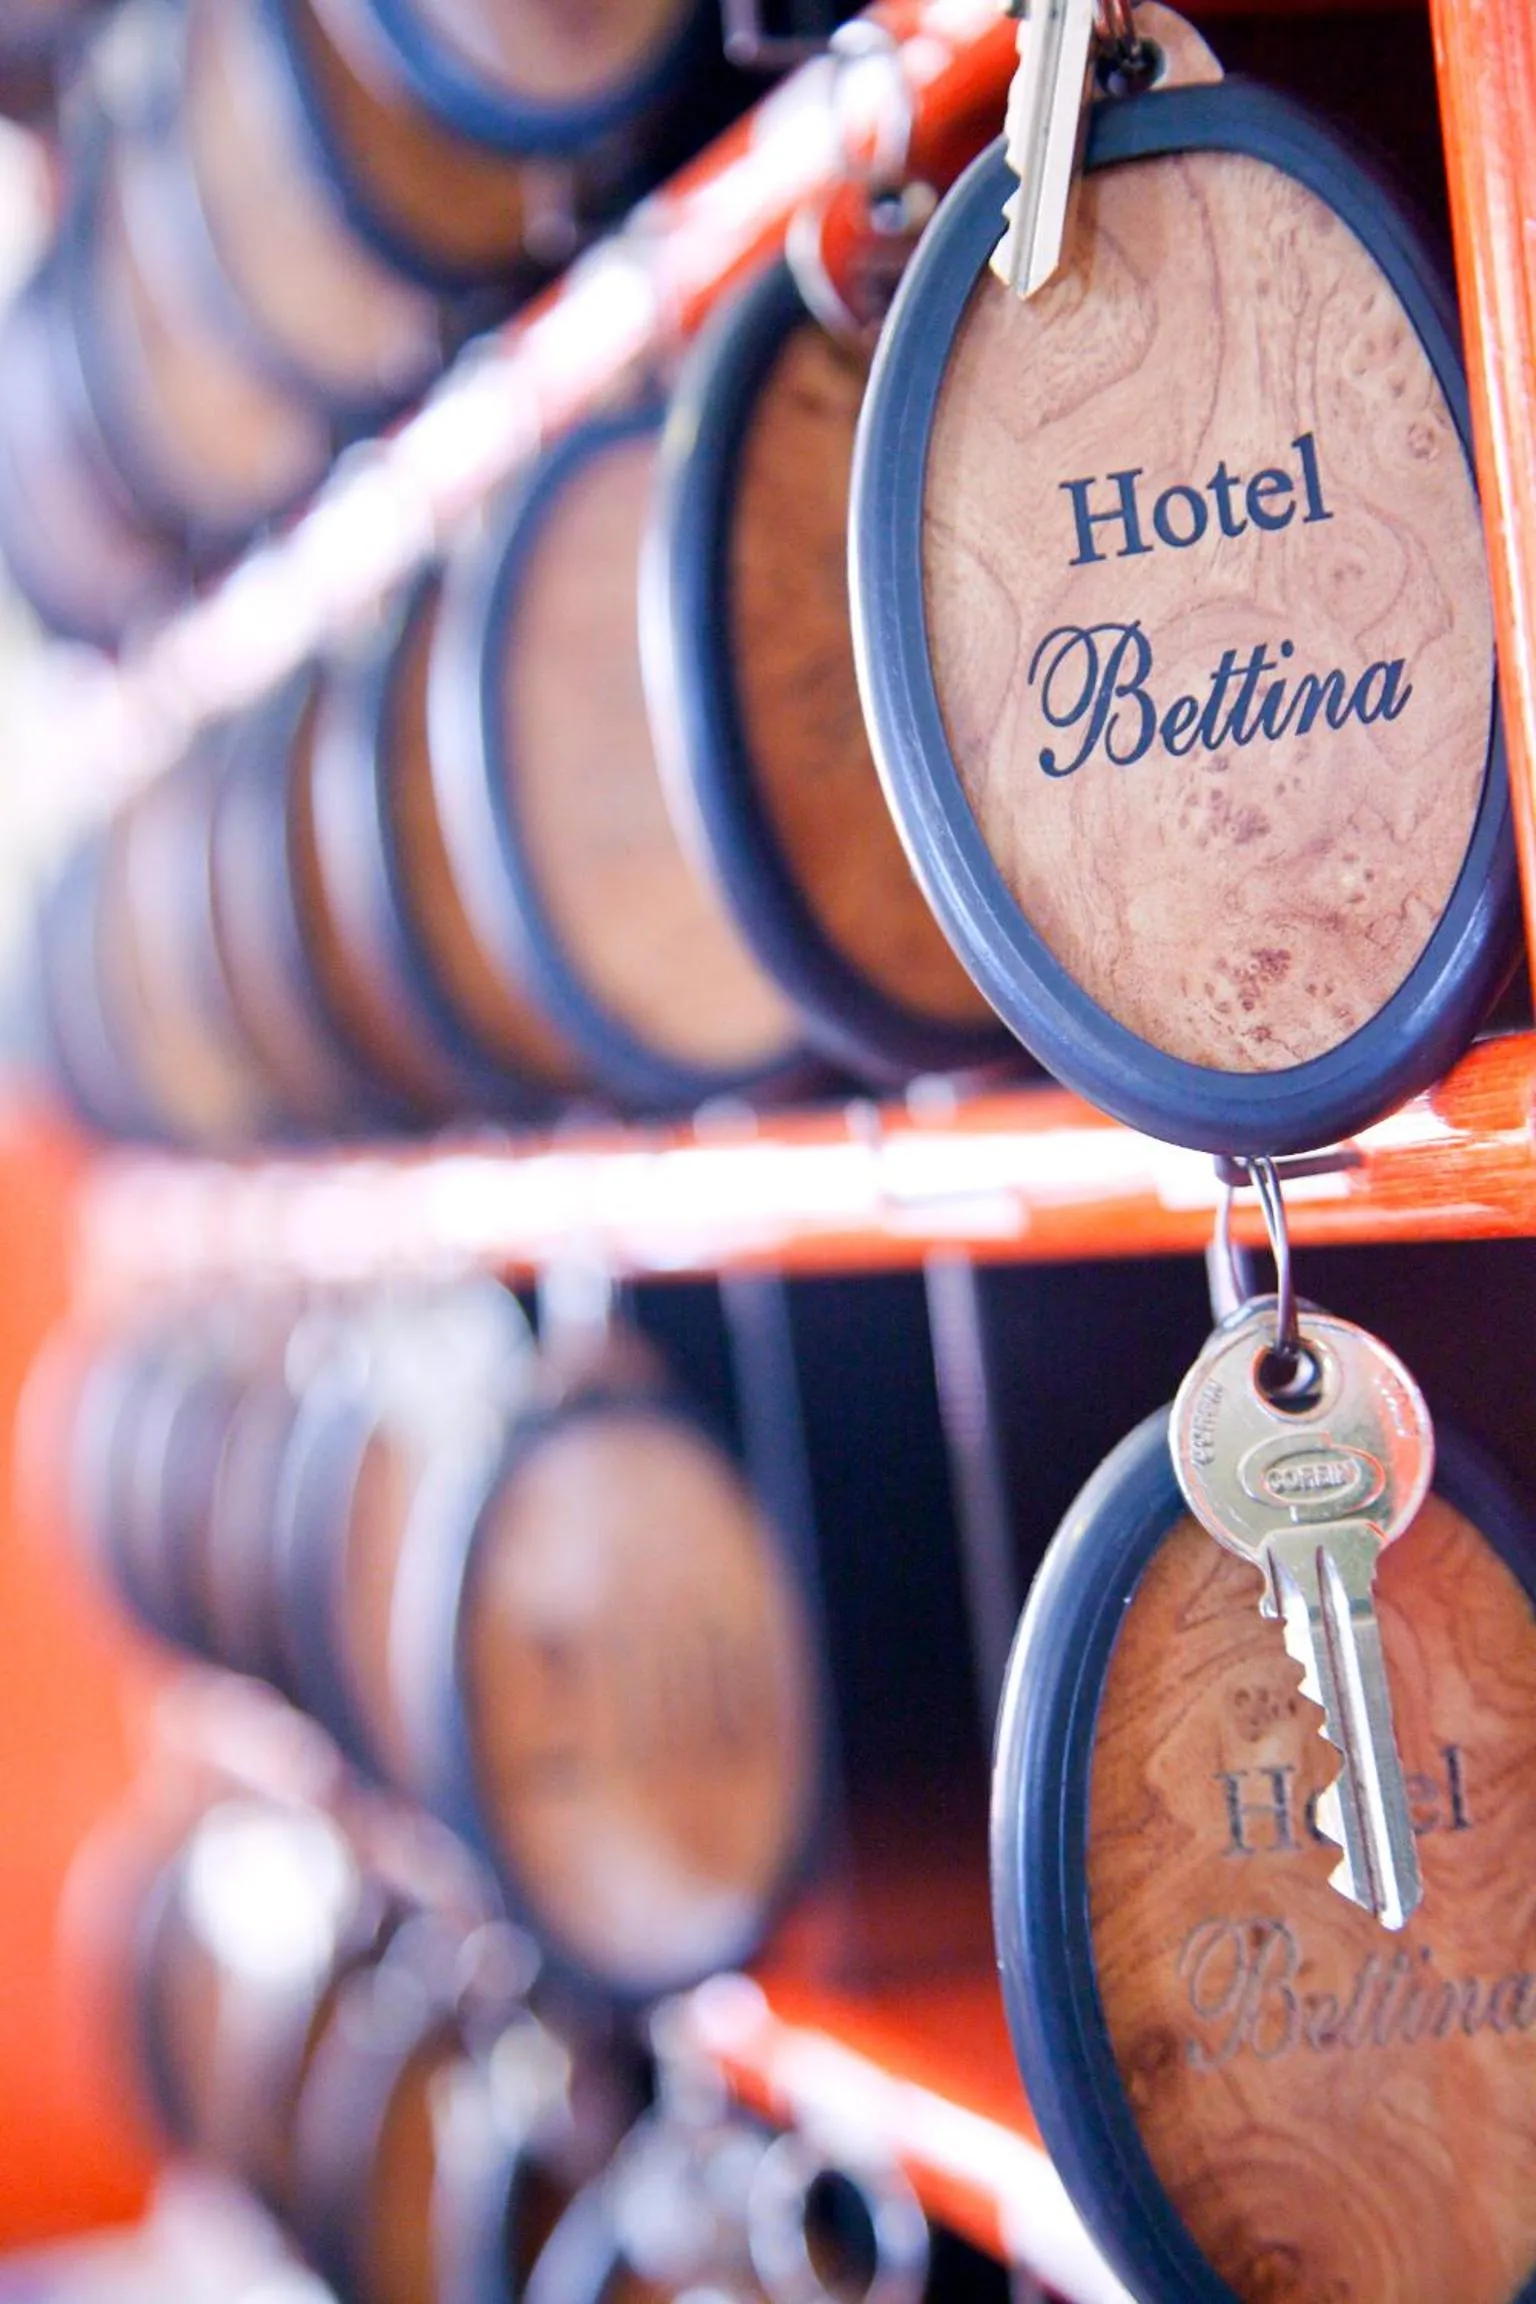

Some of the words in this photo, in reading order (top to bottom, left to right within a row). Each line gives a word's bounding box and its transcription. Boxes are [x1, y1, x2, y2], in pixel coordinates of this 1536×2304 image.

[1058, 431, 1333, 567] Hotel
[1027, 620, 1413, 778] Bettina
[1175, 1916, 1536, 2073] Bettina
